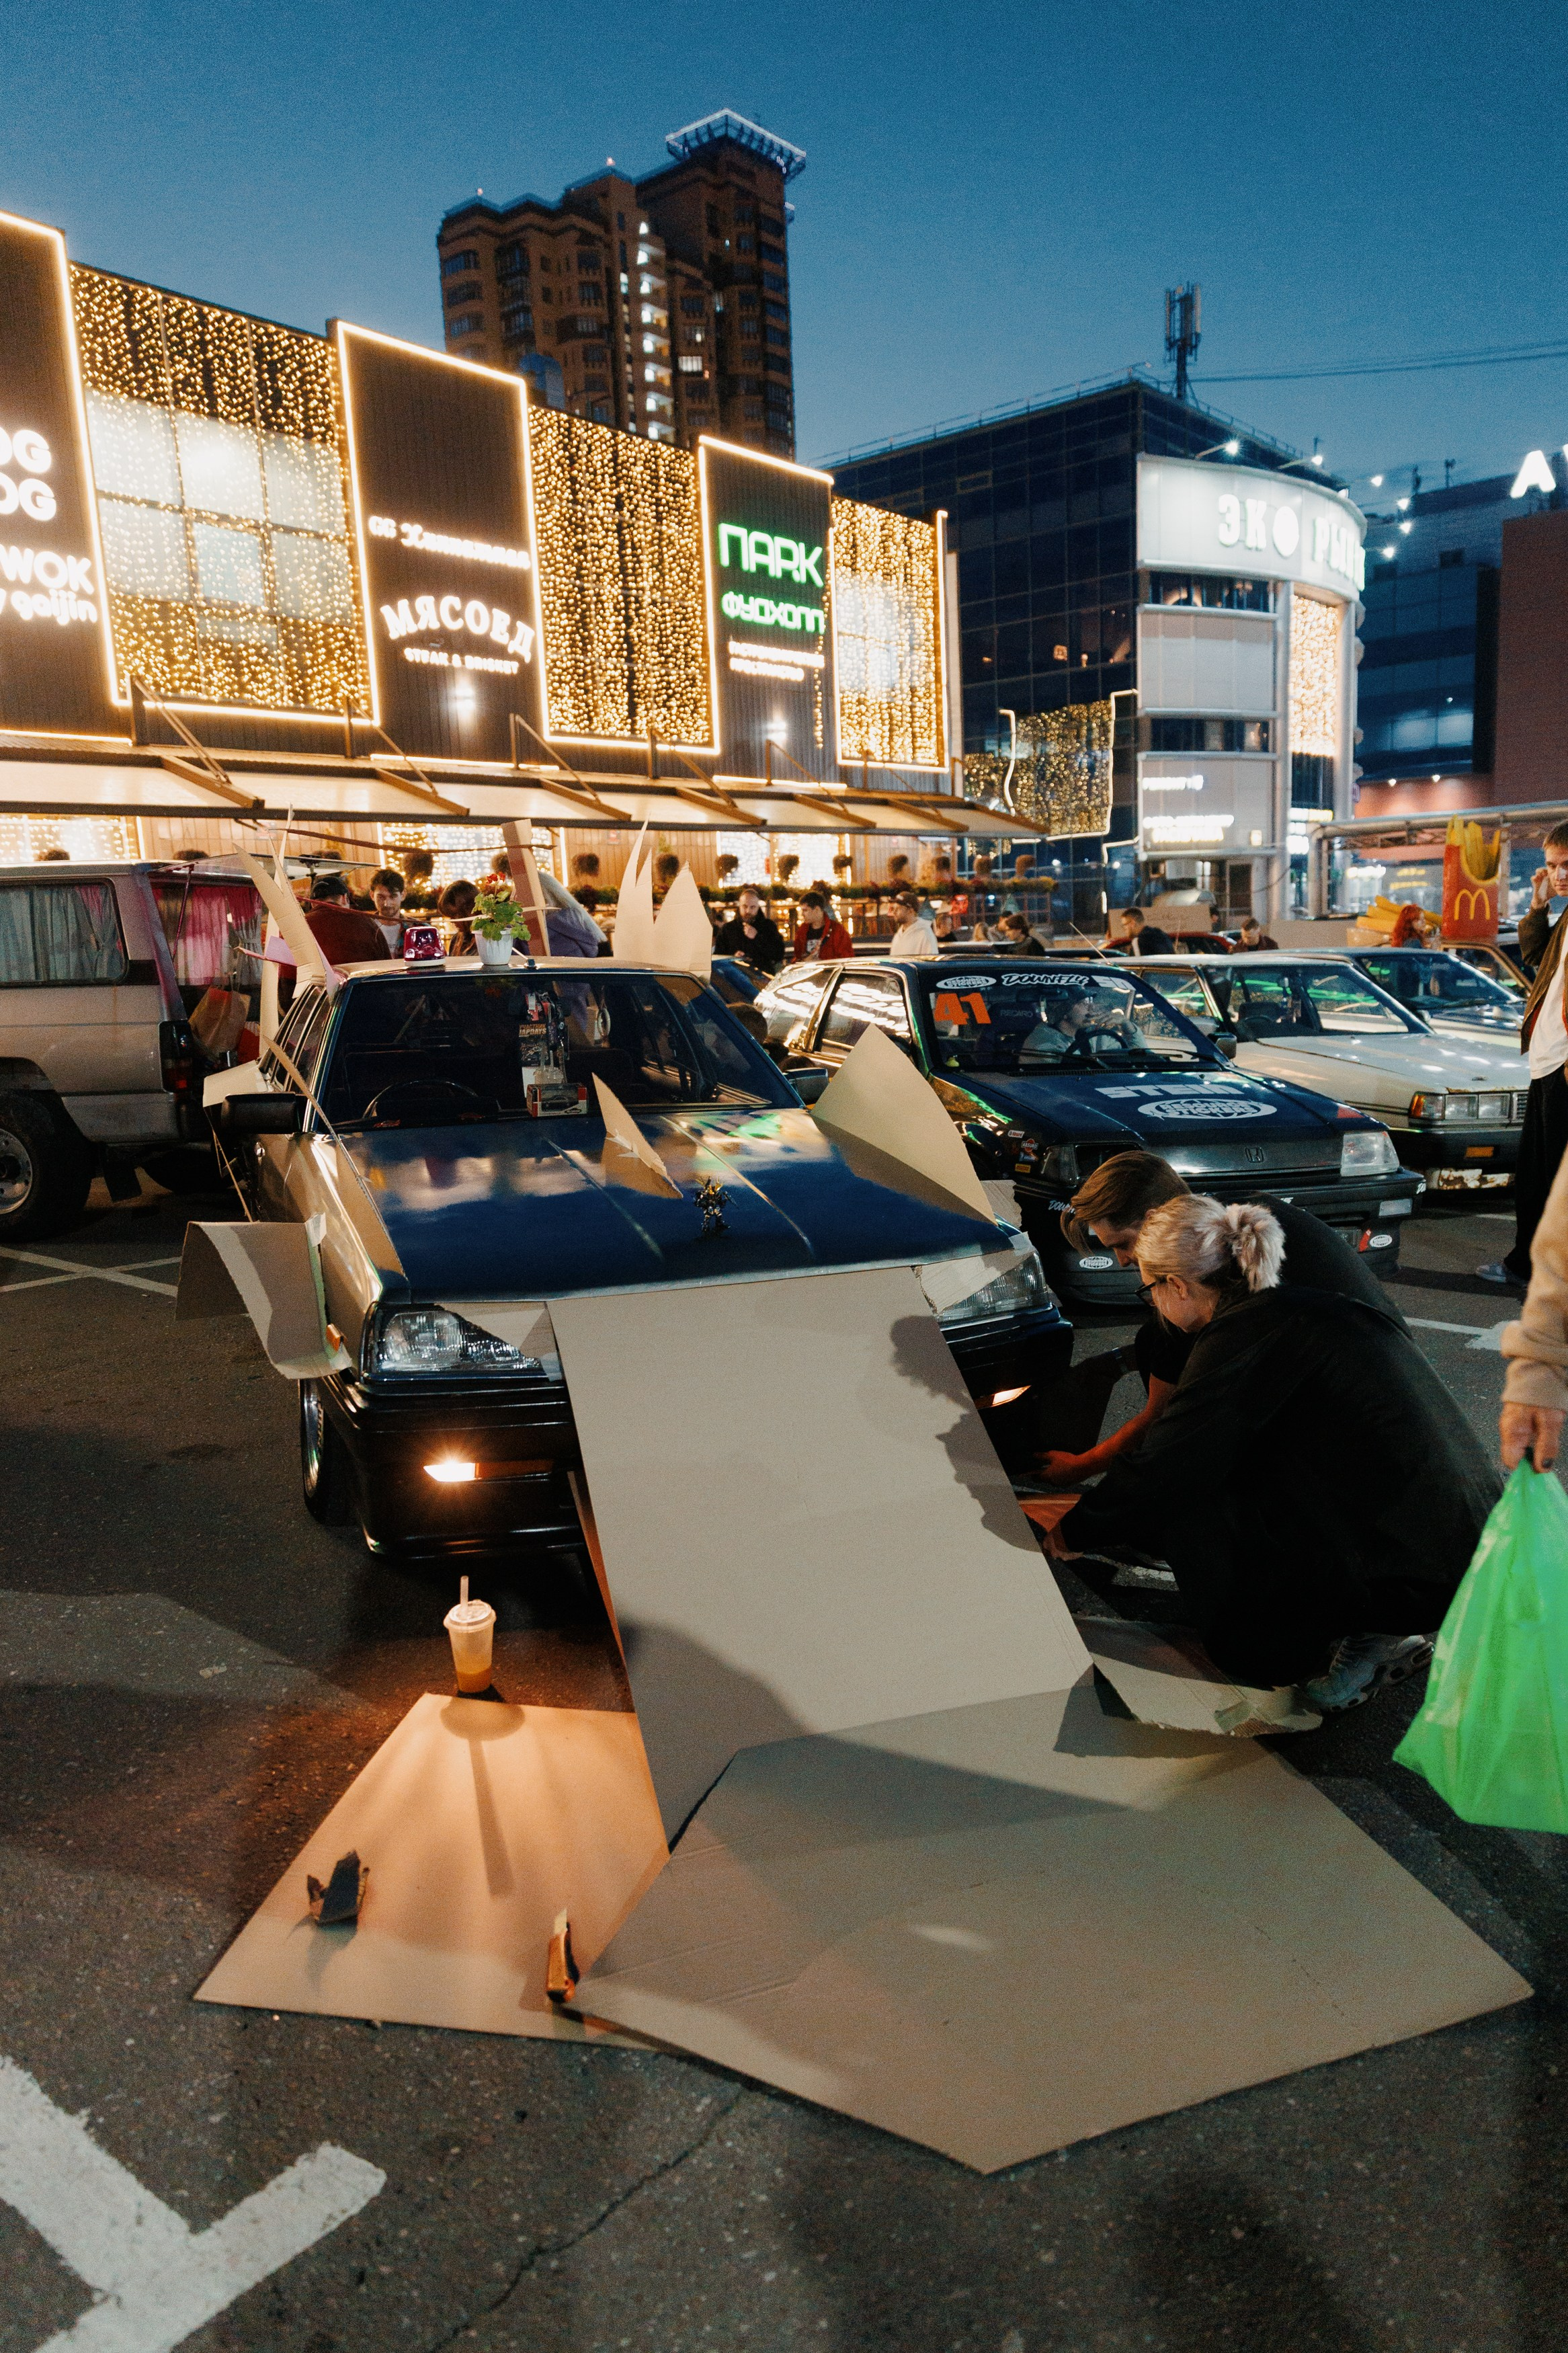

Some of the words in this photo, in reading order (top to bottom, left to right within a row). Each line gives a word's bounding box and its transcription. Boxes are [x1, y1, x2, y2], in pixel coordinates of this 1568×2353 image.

[722, 591, 825, 634] ФУДХОЛЛ
[380, 596, 535, 663] МЯСОЕД
[404, 647, 449, 667] STEAK
[464, 655, 519, 674] BRISKET
[934, 992, 991, 1025] 41
[1159, 1102, 1251, 1110] RESOURCE
[1165, 1107, 1258, 1116] STICKERS
